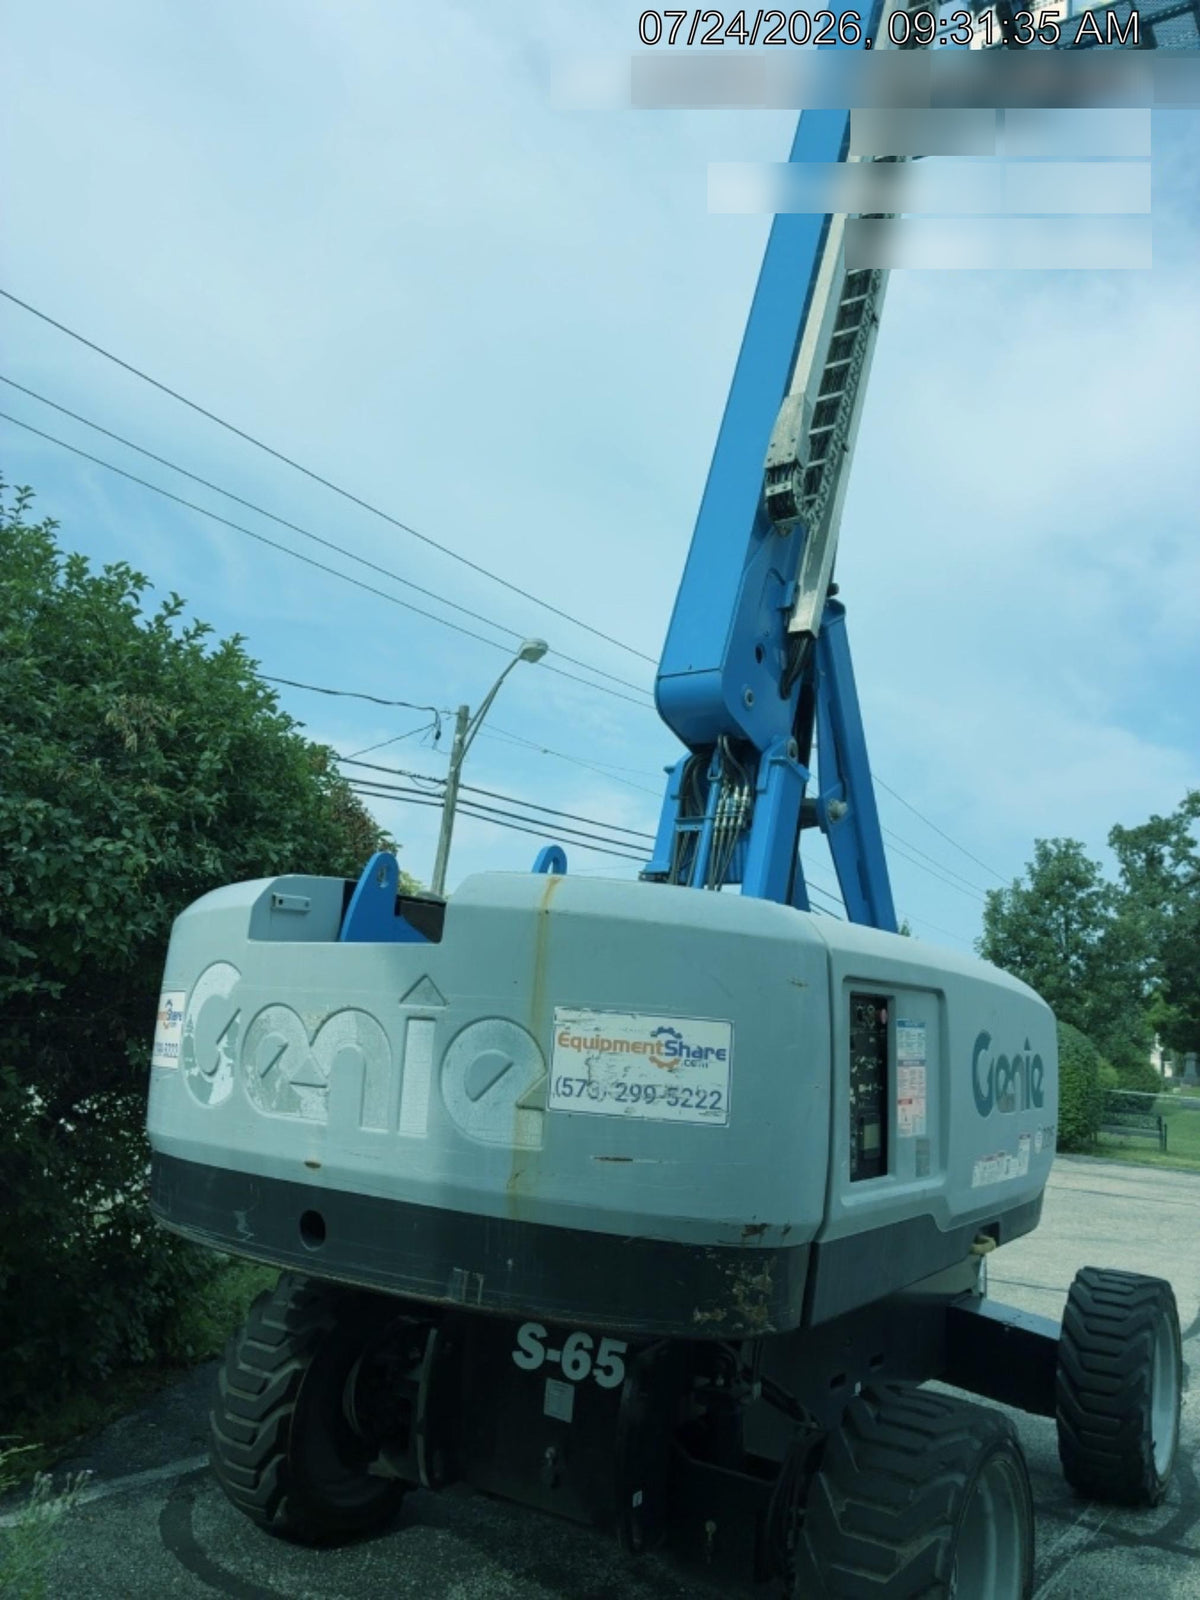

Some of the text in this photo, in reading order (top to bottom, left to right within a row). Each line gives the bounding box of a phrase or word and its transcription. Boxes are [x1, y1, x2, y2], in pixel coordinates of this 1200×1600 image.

[182, 960, 547, 1148] Genie
[557, 1030, 727, 1062] EquipmentShare
[972, 1030, 1044, 1118] Genie
[511, 1321, 628, 1390] S-65
